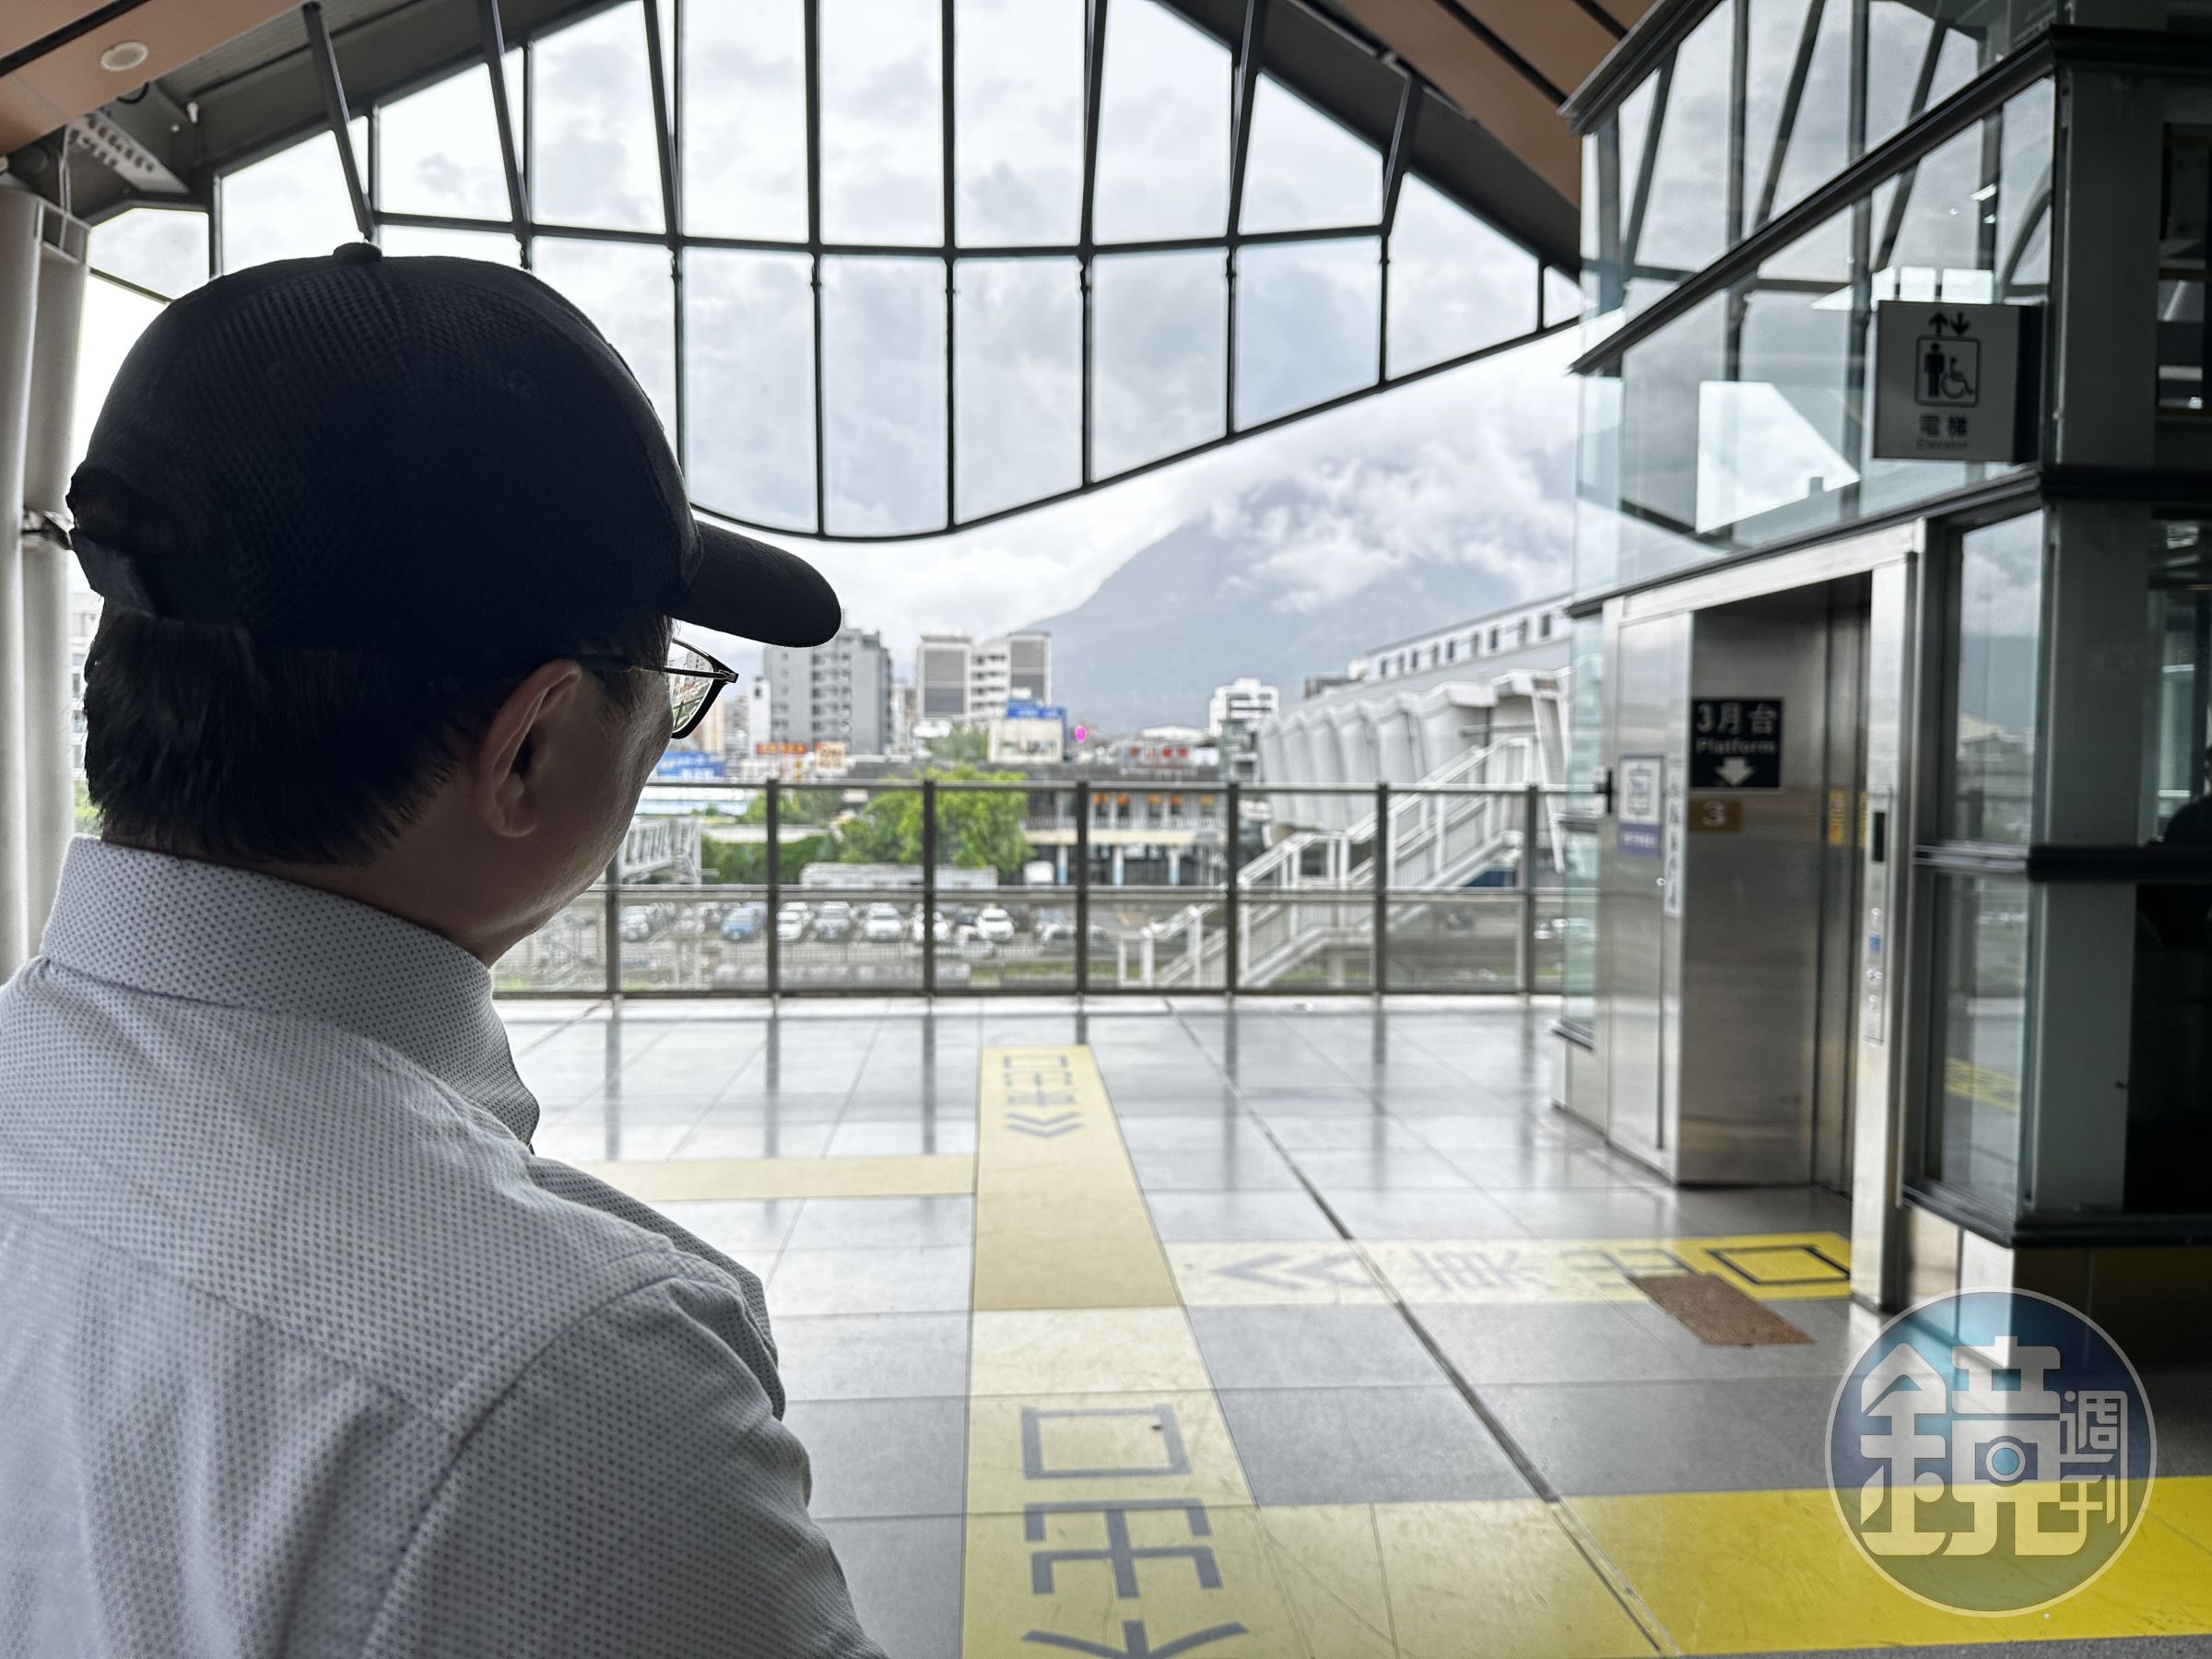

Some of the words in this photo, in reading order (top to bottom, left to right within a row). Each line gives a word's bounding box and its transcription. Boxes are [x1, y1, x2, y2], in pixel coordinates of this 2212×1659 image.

[1919, 414, 1969, 436] 電梯
[1695, 702, 1778, 735] 3月台
[1696, 737, 1775, 755] Platform
[1701, 801, 1726, 827] 3
